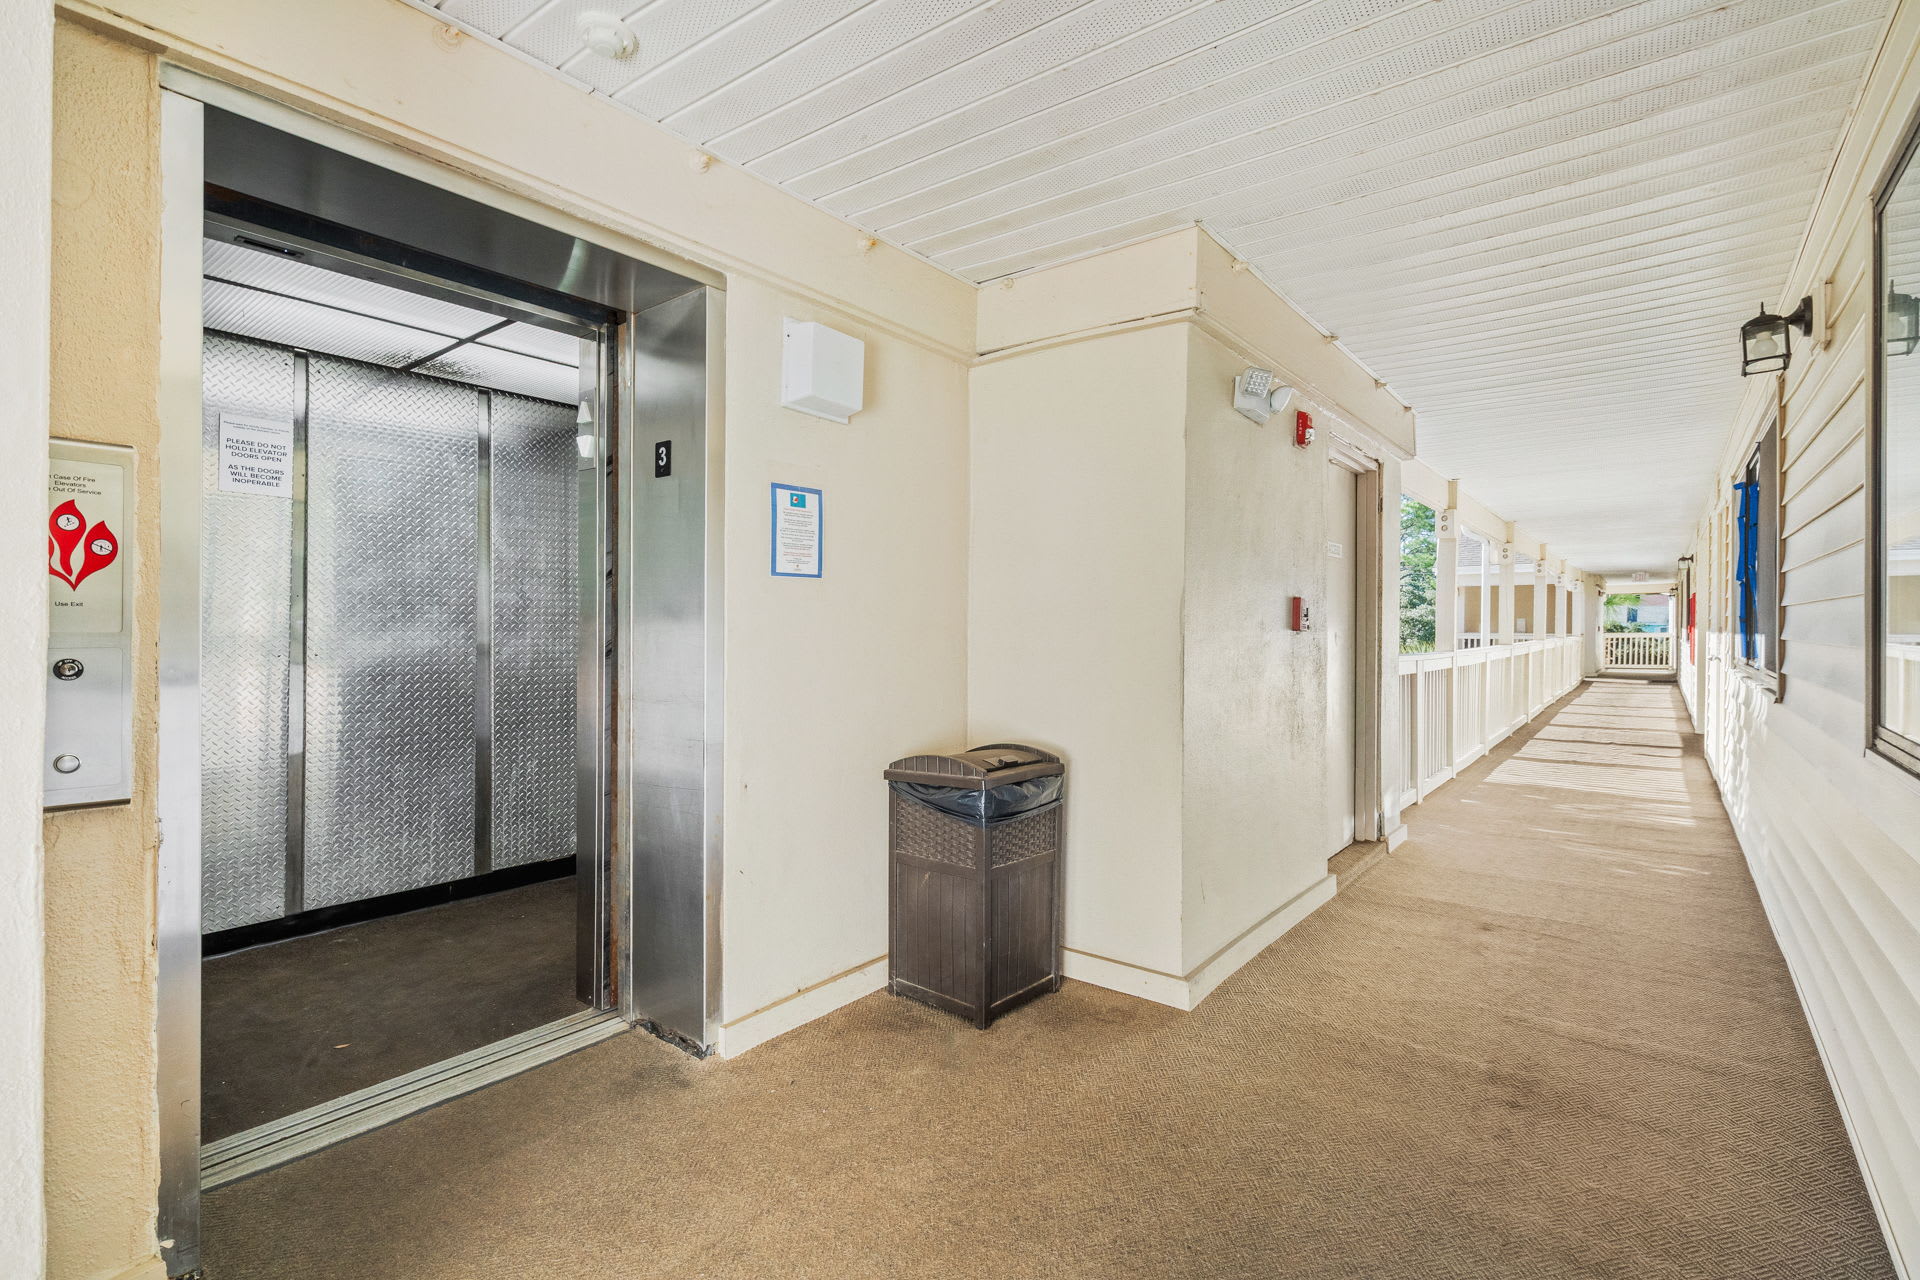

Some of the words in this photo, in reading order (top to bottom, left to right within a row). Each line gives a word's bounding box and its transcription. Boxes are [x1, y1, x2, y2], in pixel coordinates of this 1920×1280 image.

[226, 437, 256, 447] PLEASE
[225, 444, 248, 452] HOLD
[249, 447, 288, 457] ELEVATOR
[231, 451, 259, 460] DOORS
[261, 455, 282, 463] OPEN
[658, 446, 667, 466] 3
[257, 467, 285, 476] DOORS
[53, 473, 71, 481] Case
[250, 473, 282, 482] BECOME
[54, 480, 87, 488] Elevators
[232, 477, 280, 488] INOPERABLE
[77, 488, 102, 496] Service
